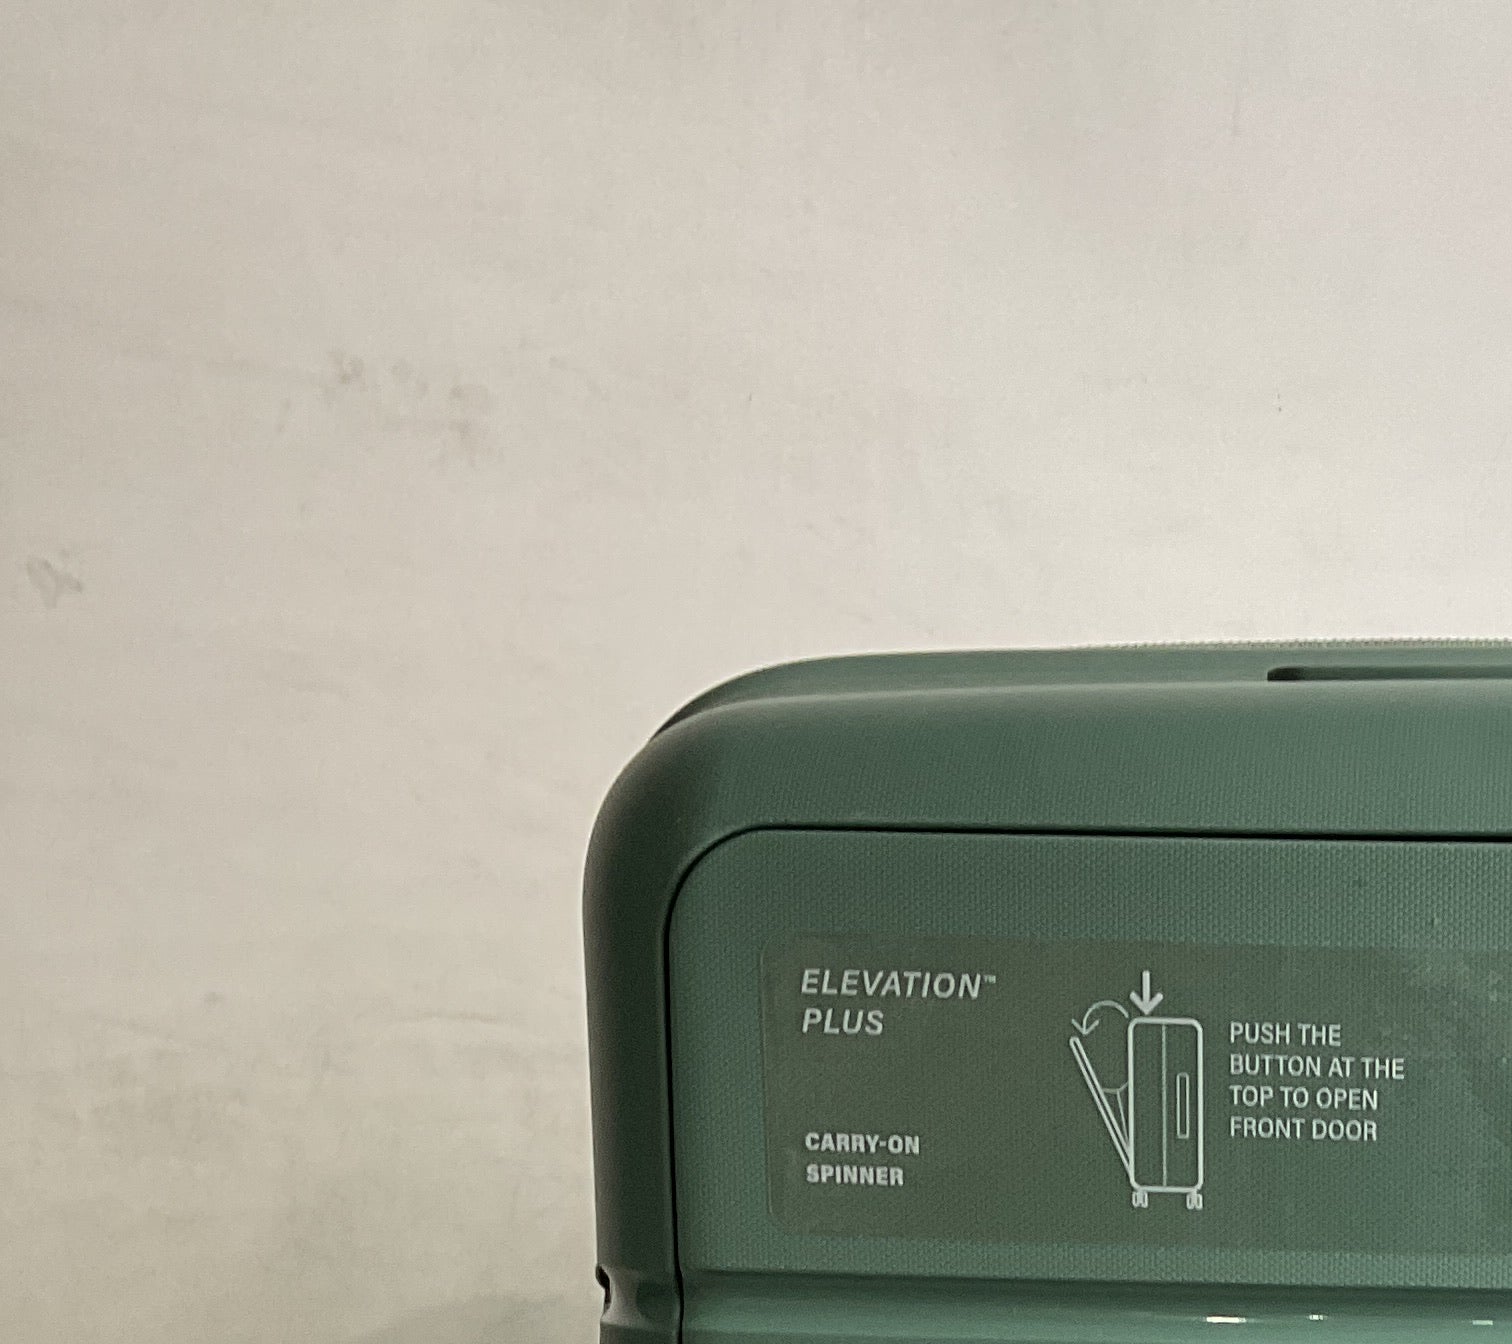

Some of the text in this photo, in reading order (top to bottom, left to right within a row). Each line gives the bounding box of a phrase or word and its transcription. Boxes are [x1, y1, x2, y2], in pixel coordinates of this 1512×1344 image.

[801, 1008, 885, 1035] PLUS
[1230, 1020, 1342, 1047] PUSH THE
[1230, 1053, 1405, 1080] BUTTON AT THE
[1229, 1084, 1378, 1111] TOP TO OPEN
[1229, 1115, 1378, 1142] FRONT DOOR
[805, 1132, 921, 1156] CARRY-ON
[806, 1164, 905, 1187] SPINNER
